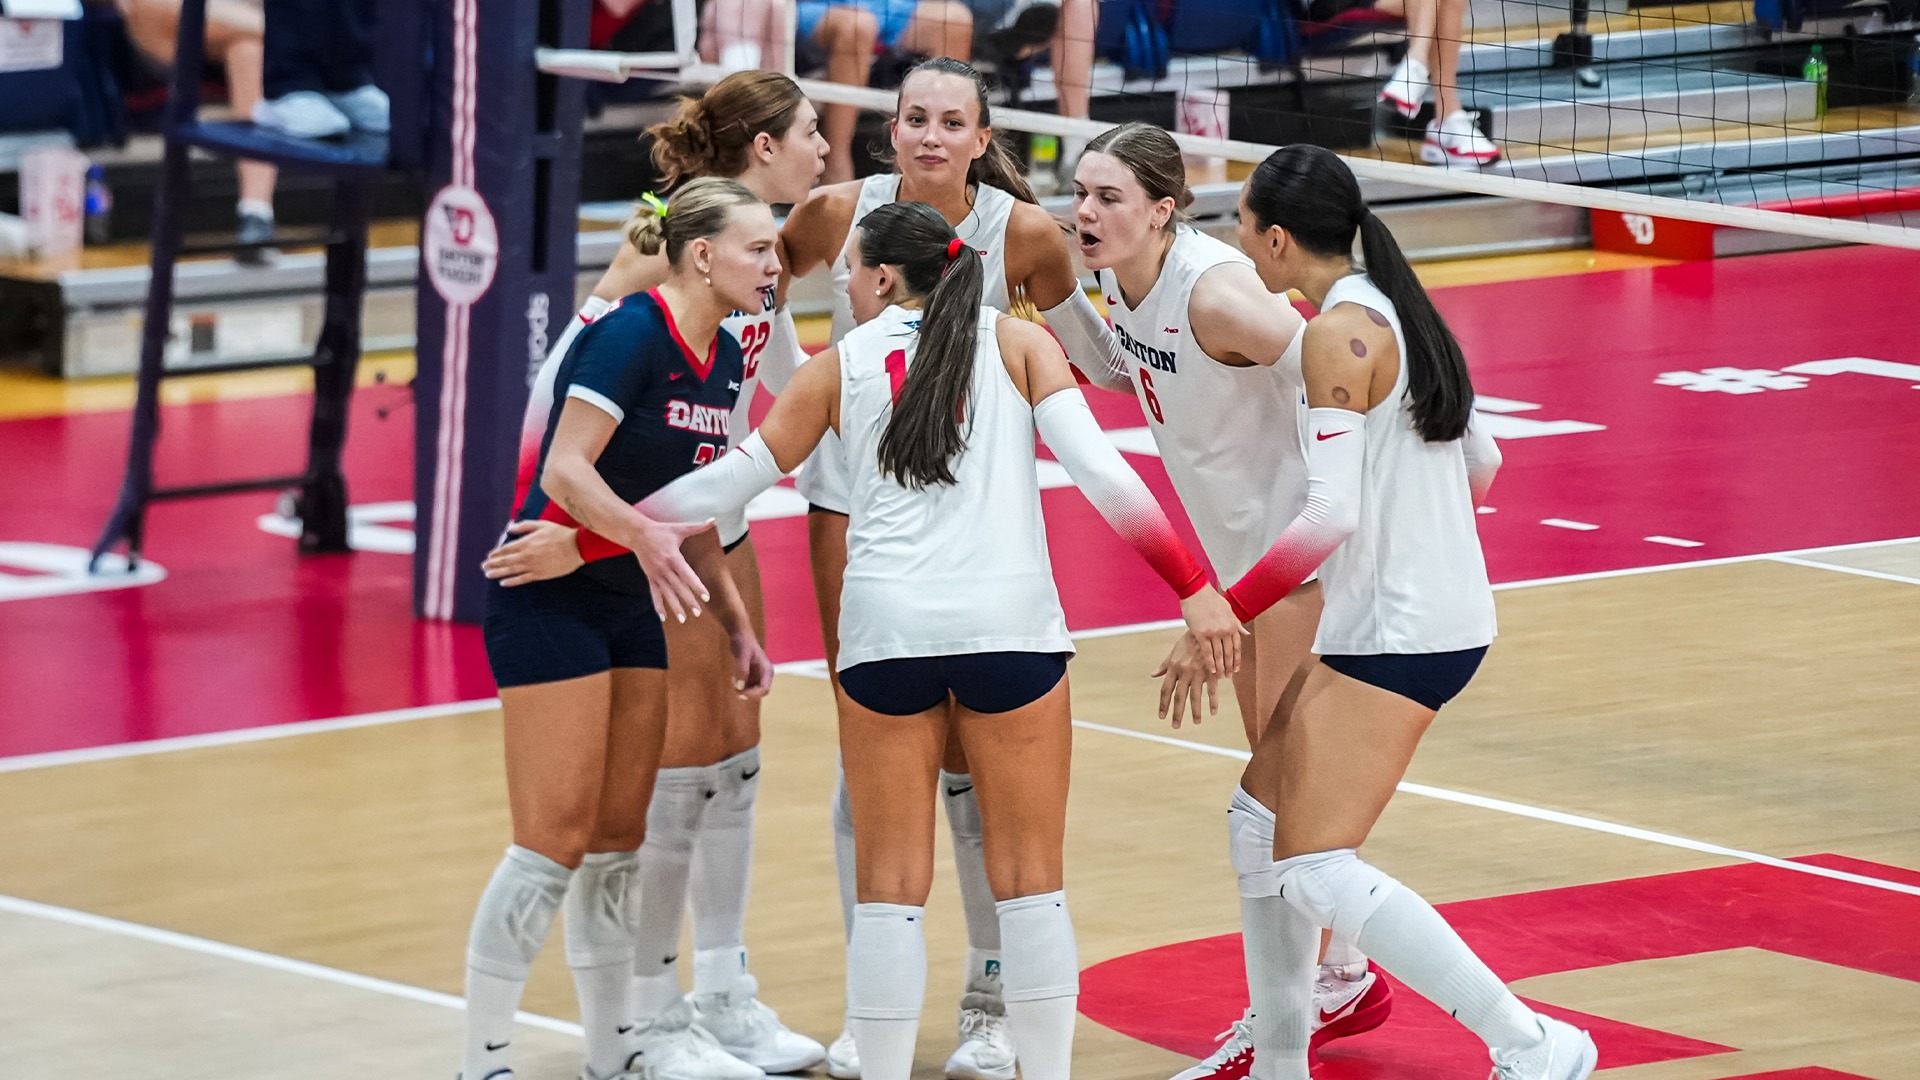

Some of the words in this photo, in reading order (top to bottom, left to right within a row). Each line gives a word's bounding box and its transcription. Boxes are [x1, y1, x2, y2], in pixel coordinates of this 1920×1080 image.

[741, 321, 770, 379] 22
[664, 399, 730, 437] DAYTO
[1139, 367, 1164, 425] 6
